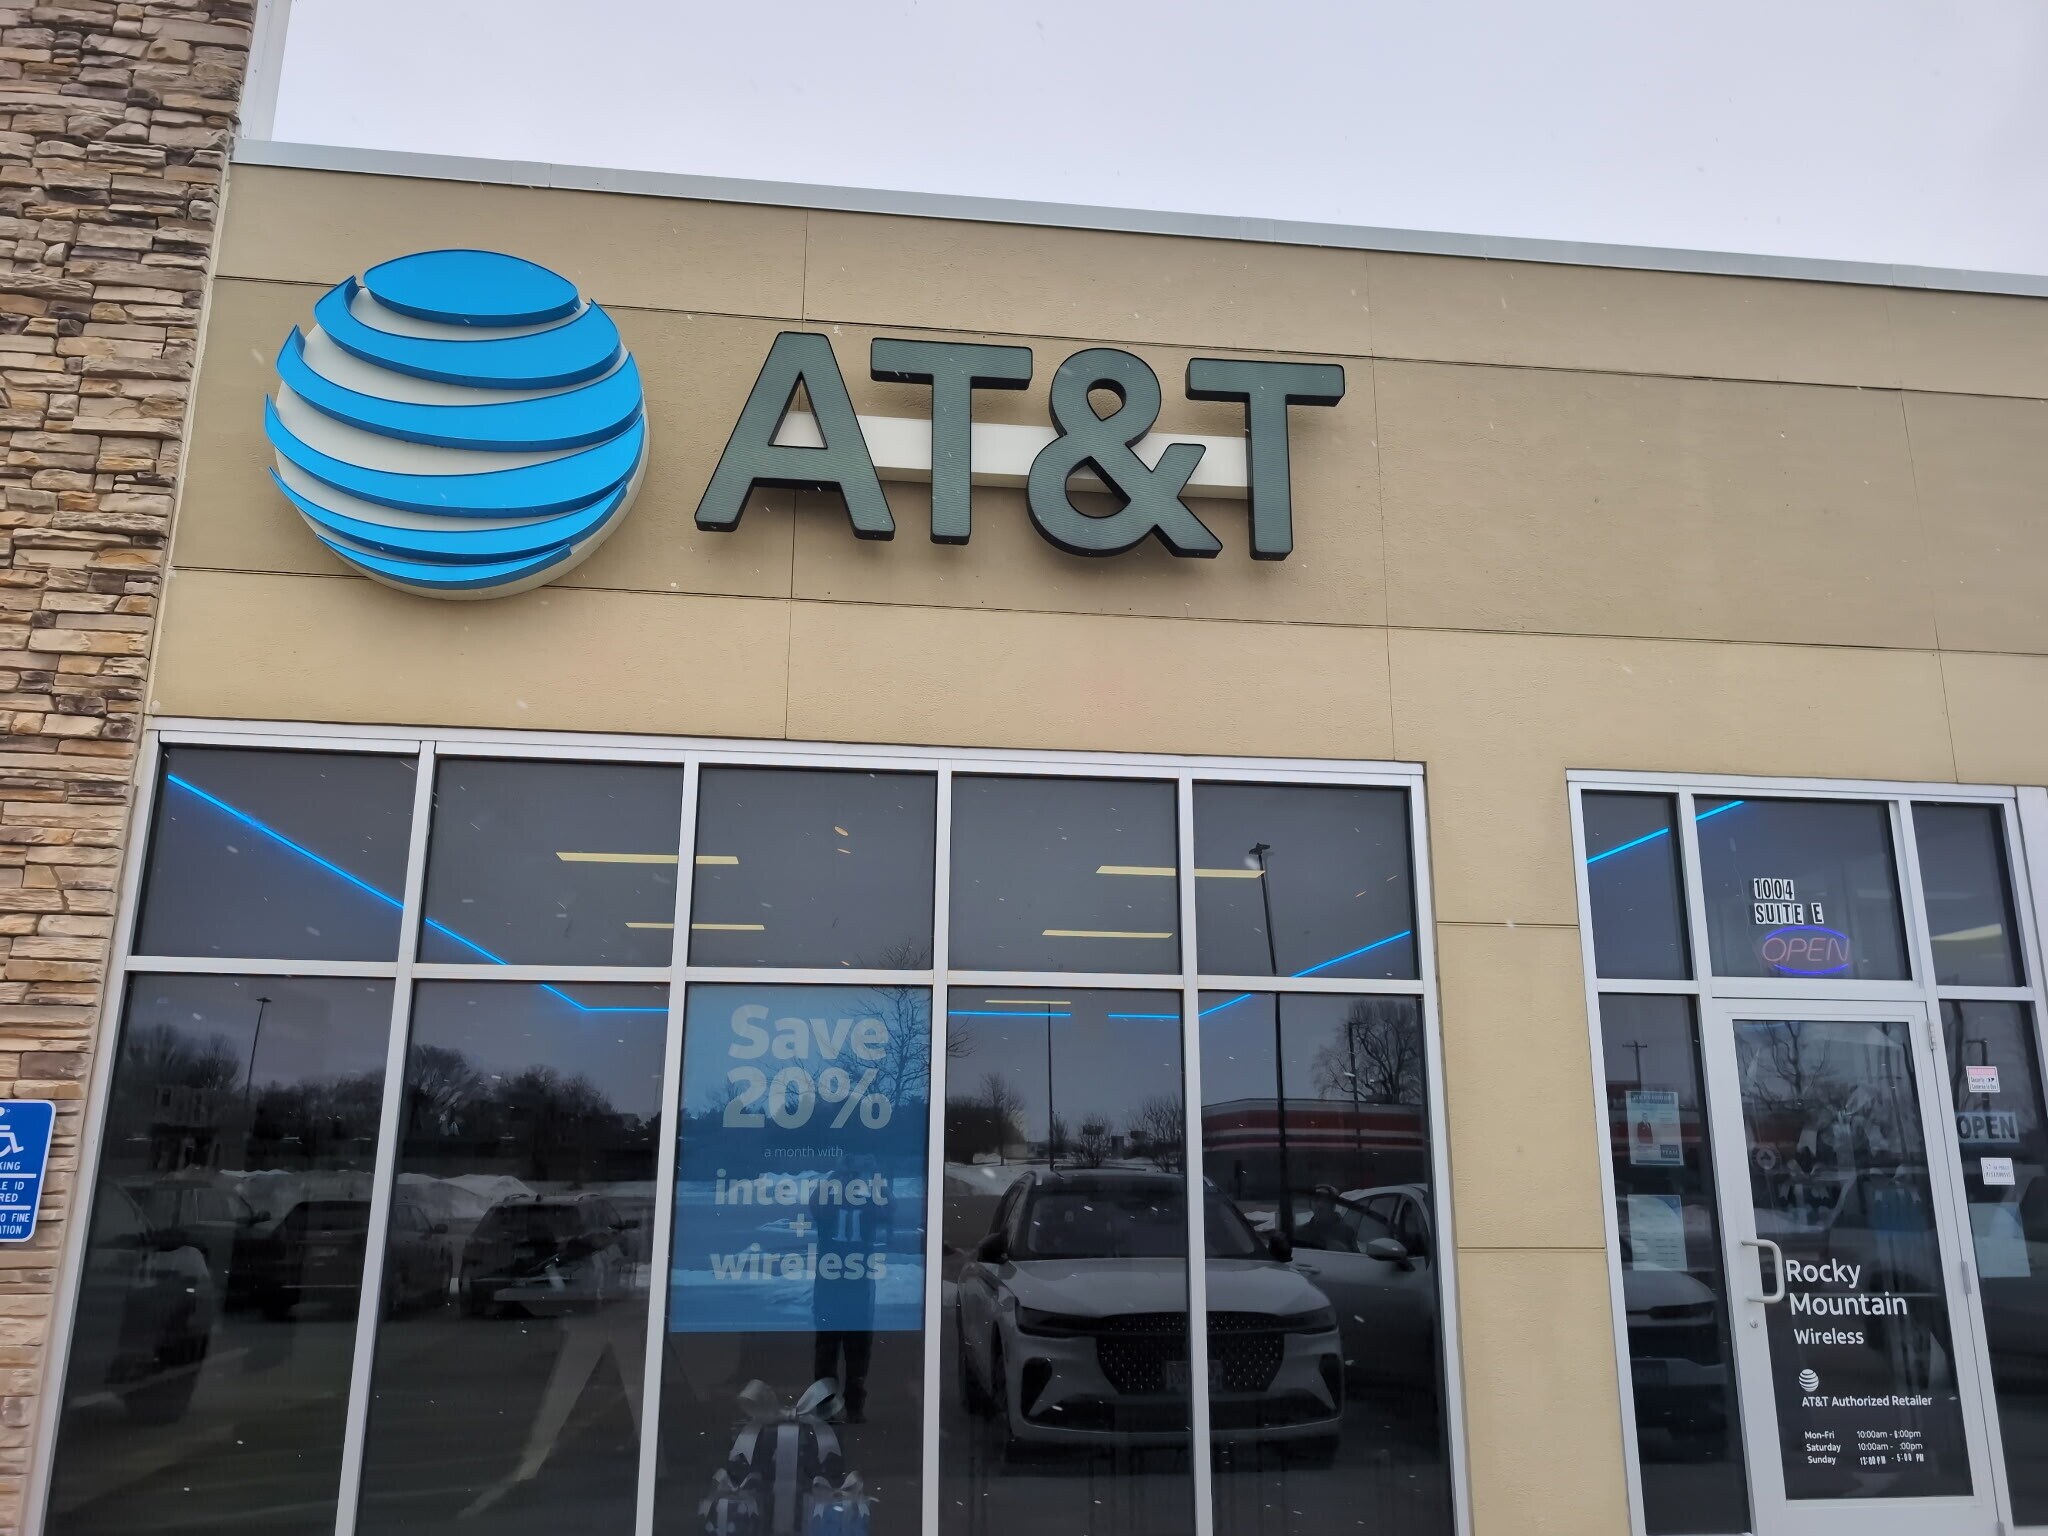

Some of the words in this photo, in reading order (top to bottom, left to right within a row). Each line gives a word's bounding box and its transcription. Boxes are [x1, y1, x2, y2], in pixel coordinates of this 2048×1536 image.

[694, 331, 1345, 560] AT&T
[1755, 879, 1794, 899] 1004
[1755, 903, 1803, 924] SUITE
[1812, 903, 1823, 923] E
[1762, 937, 1849, 961] OPEN
[727, 1004, 888, 1060] Save
[723, 1066, 892, 1129] 20%
[1956, 1115, 2016, 1139] OPEN
[764, 1148, 771, 1157] a
[774, 1145, 815, 1157] month
[817, 1145, 843, 1157] with
[14, 1181, 25, 1190] ID
[715, 1169, 888, 1205] internet
[11, 1213, 31, 1222] FINE
[710, 1243, 887, 1280] wireless
[1785, 1258, 1861, 1288] Rocky
[1789, 1291, 1908, 1316] Mountain
[1793, 1328, 1864, 1345] Wireless
[1802, 1396, 1828, 1407] AT&T
[1832, 1395, 1889, 1407] Authorized
[1892, 1394, 1933, 1406] Retailer
[1804, 1430, 1835, 1439] Mon-Fri
[1857, 1430, 1888, 1438] 10:00am
[1806, 1443, 1841, 1453] Saturday
[1857, 1442, 1889, 1451] 10:00am
[1807, 1455, 1836, 1465] Sunday
